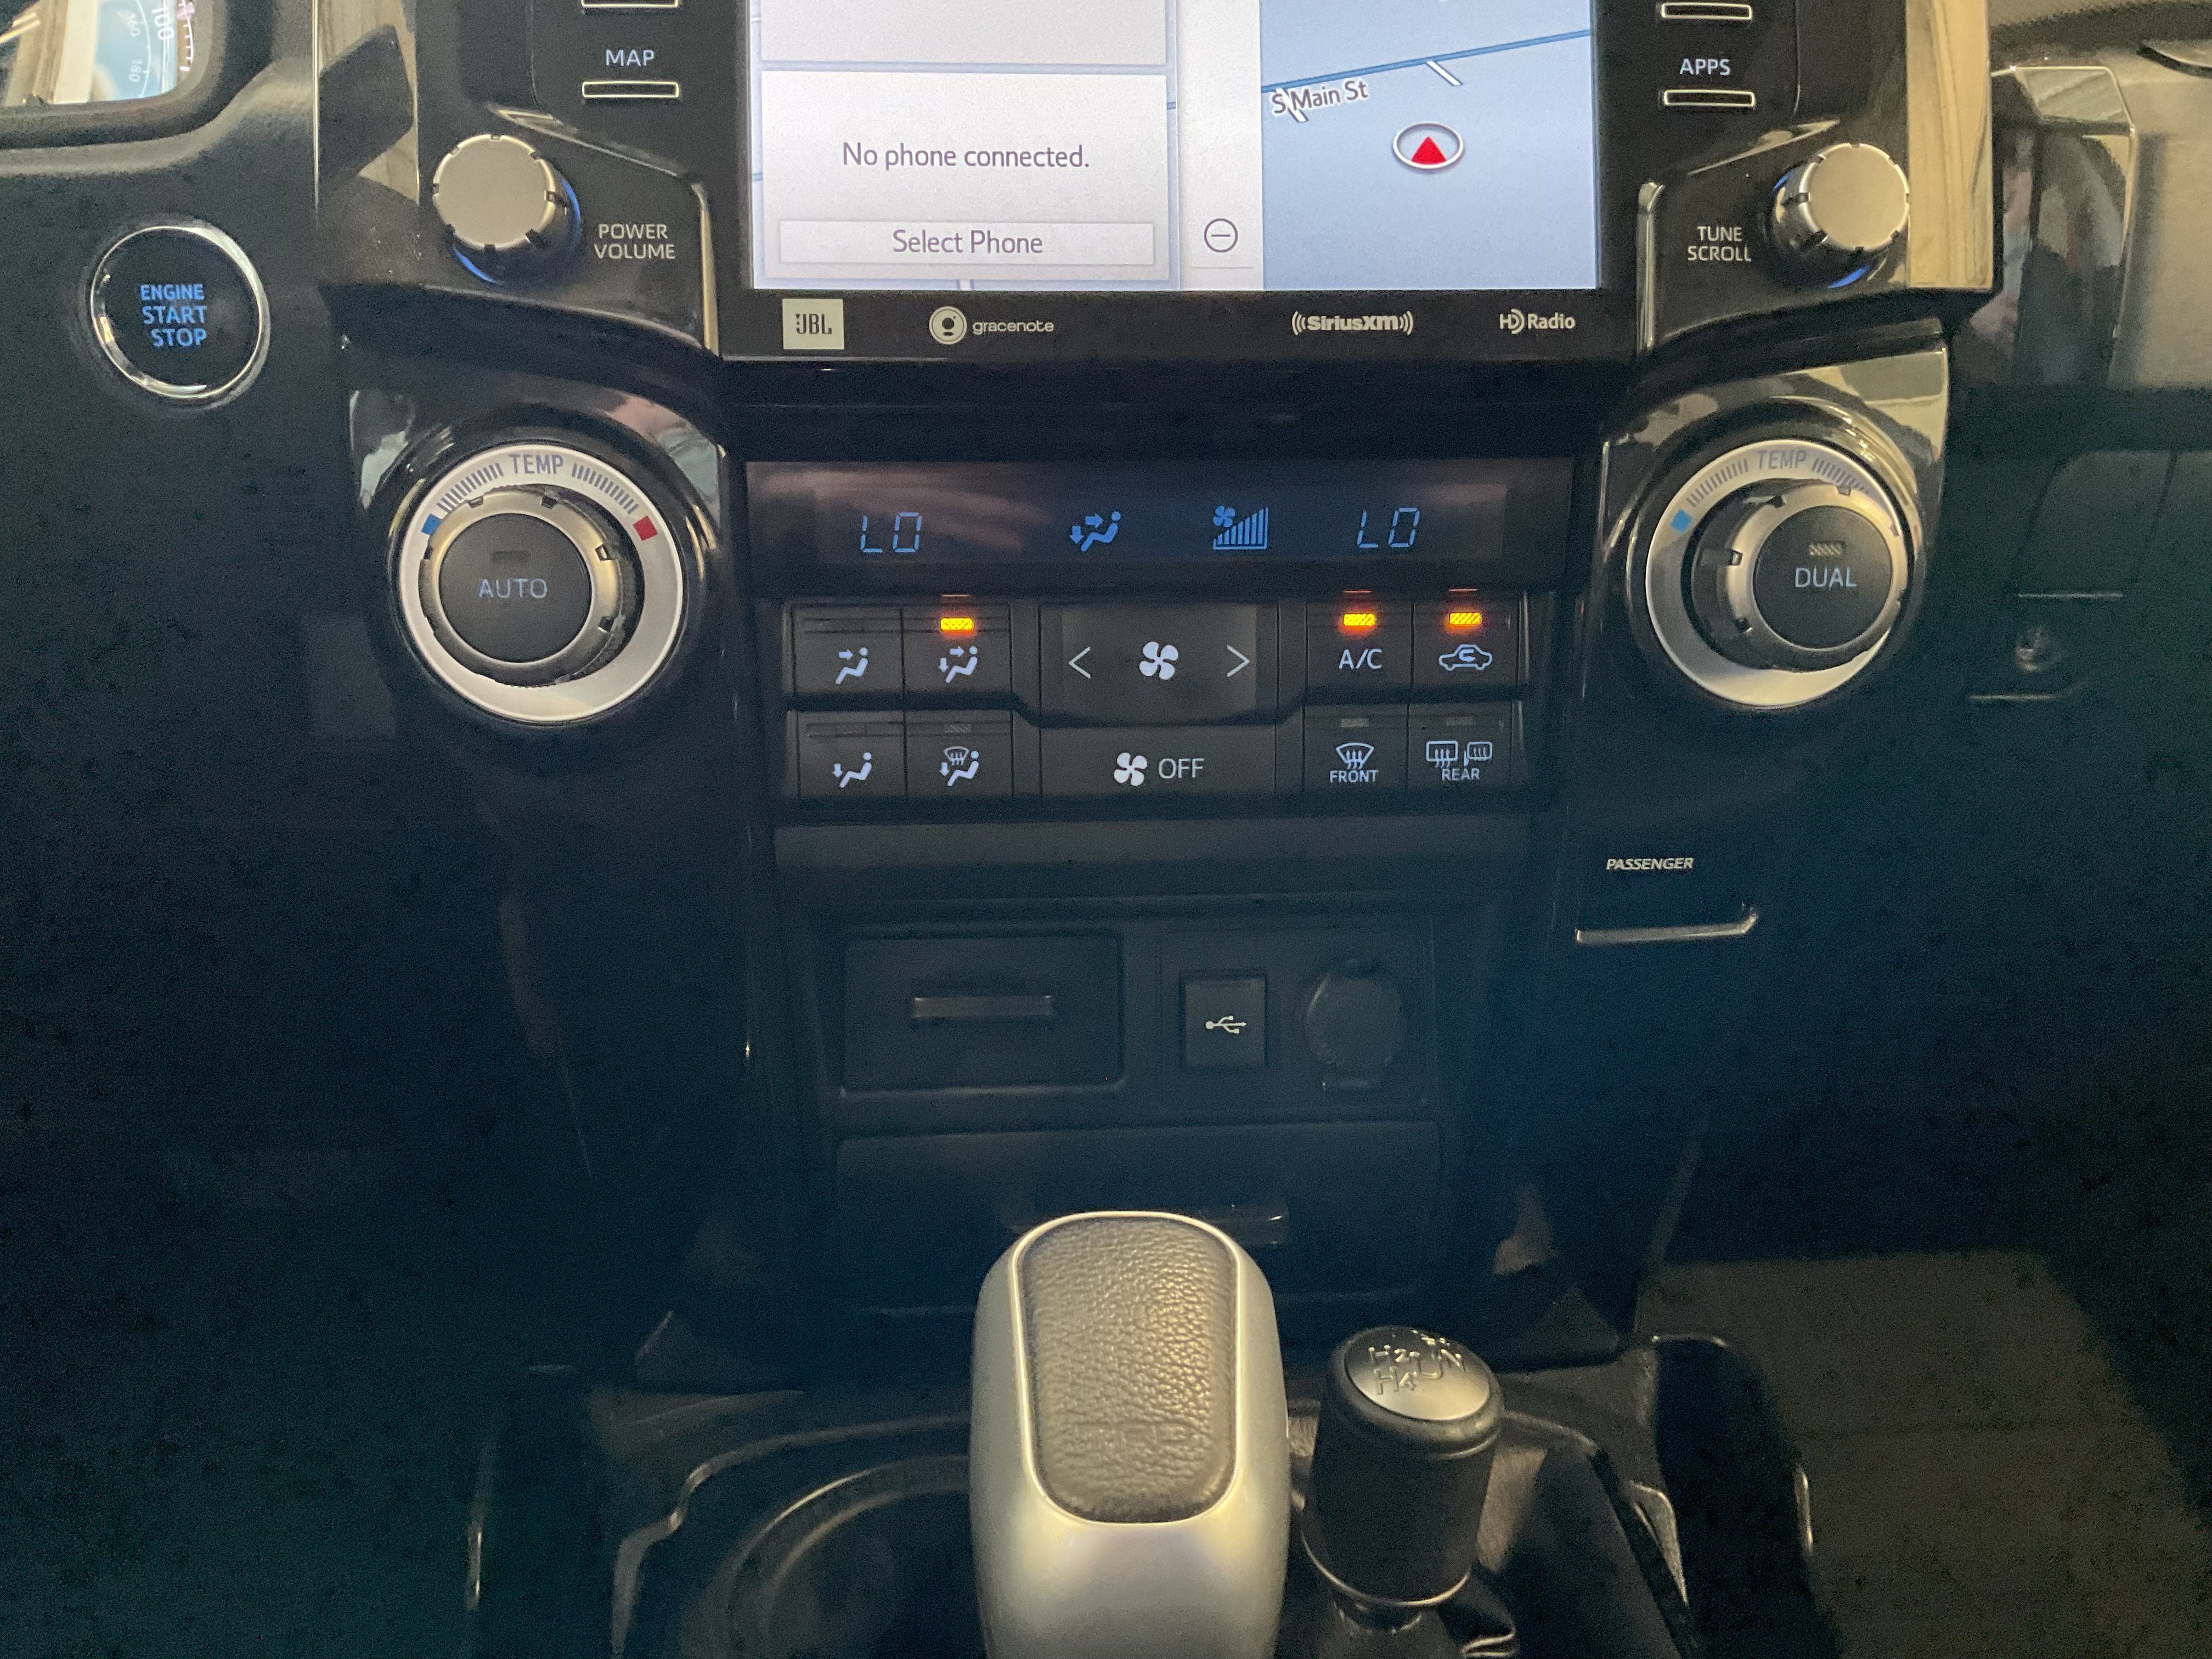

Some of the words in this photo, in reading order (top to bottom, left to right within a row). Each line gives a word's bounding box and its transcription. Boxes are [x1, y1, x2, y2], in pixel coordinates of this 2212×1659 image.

[605, 49, 655, 66] MAP
[1679, 58, 1731, 76] APPS
[1272, 92, 1287, 114] S
[1292, 85, 1341, 110] Main
[1344, 81, 1369, 100] St
[843, 142, 878, 166] No
[885, 143, 956, 171] phone
[964, 145, 1090, 167] connected.
[599, 223, 668, 239] POWER
[1698, 226, 1742, 242] TUNE
[892, 229, 964, 254] Select
[970, 230, 1043, 255] Phone
[594, 244, 675, 259] VOLUME
[1688, 246, 1752, 262] SCROLL
[140, 284, 205, 301] ENGINE
[142, 305, 207, 324] START
[1527, 313, 1576, 330] Radio
[795, 313, 832, 335] JBL
[973, 319, 1054, 332] gracenote
[151, 328, 207, 347] STOP
[509, 454, 564, 475] TEMP
[1757, 450, 1807, 470] TEMP
[1795, 567, 1858, 588] DUAL
[477, 579, 548, 599] AUTO
[1339, 648, 1383, 670] A/C
[1158, 758, 1205, 779] OFF
[1330, 770, 1379, 783] FRONT
[1441, 769, 1480, 781] REAR
[1606, 857, 1694, 871] PASSENGER
